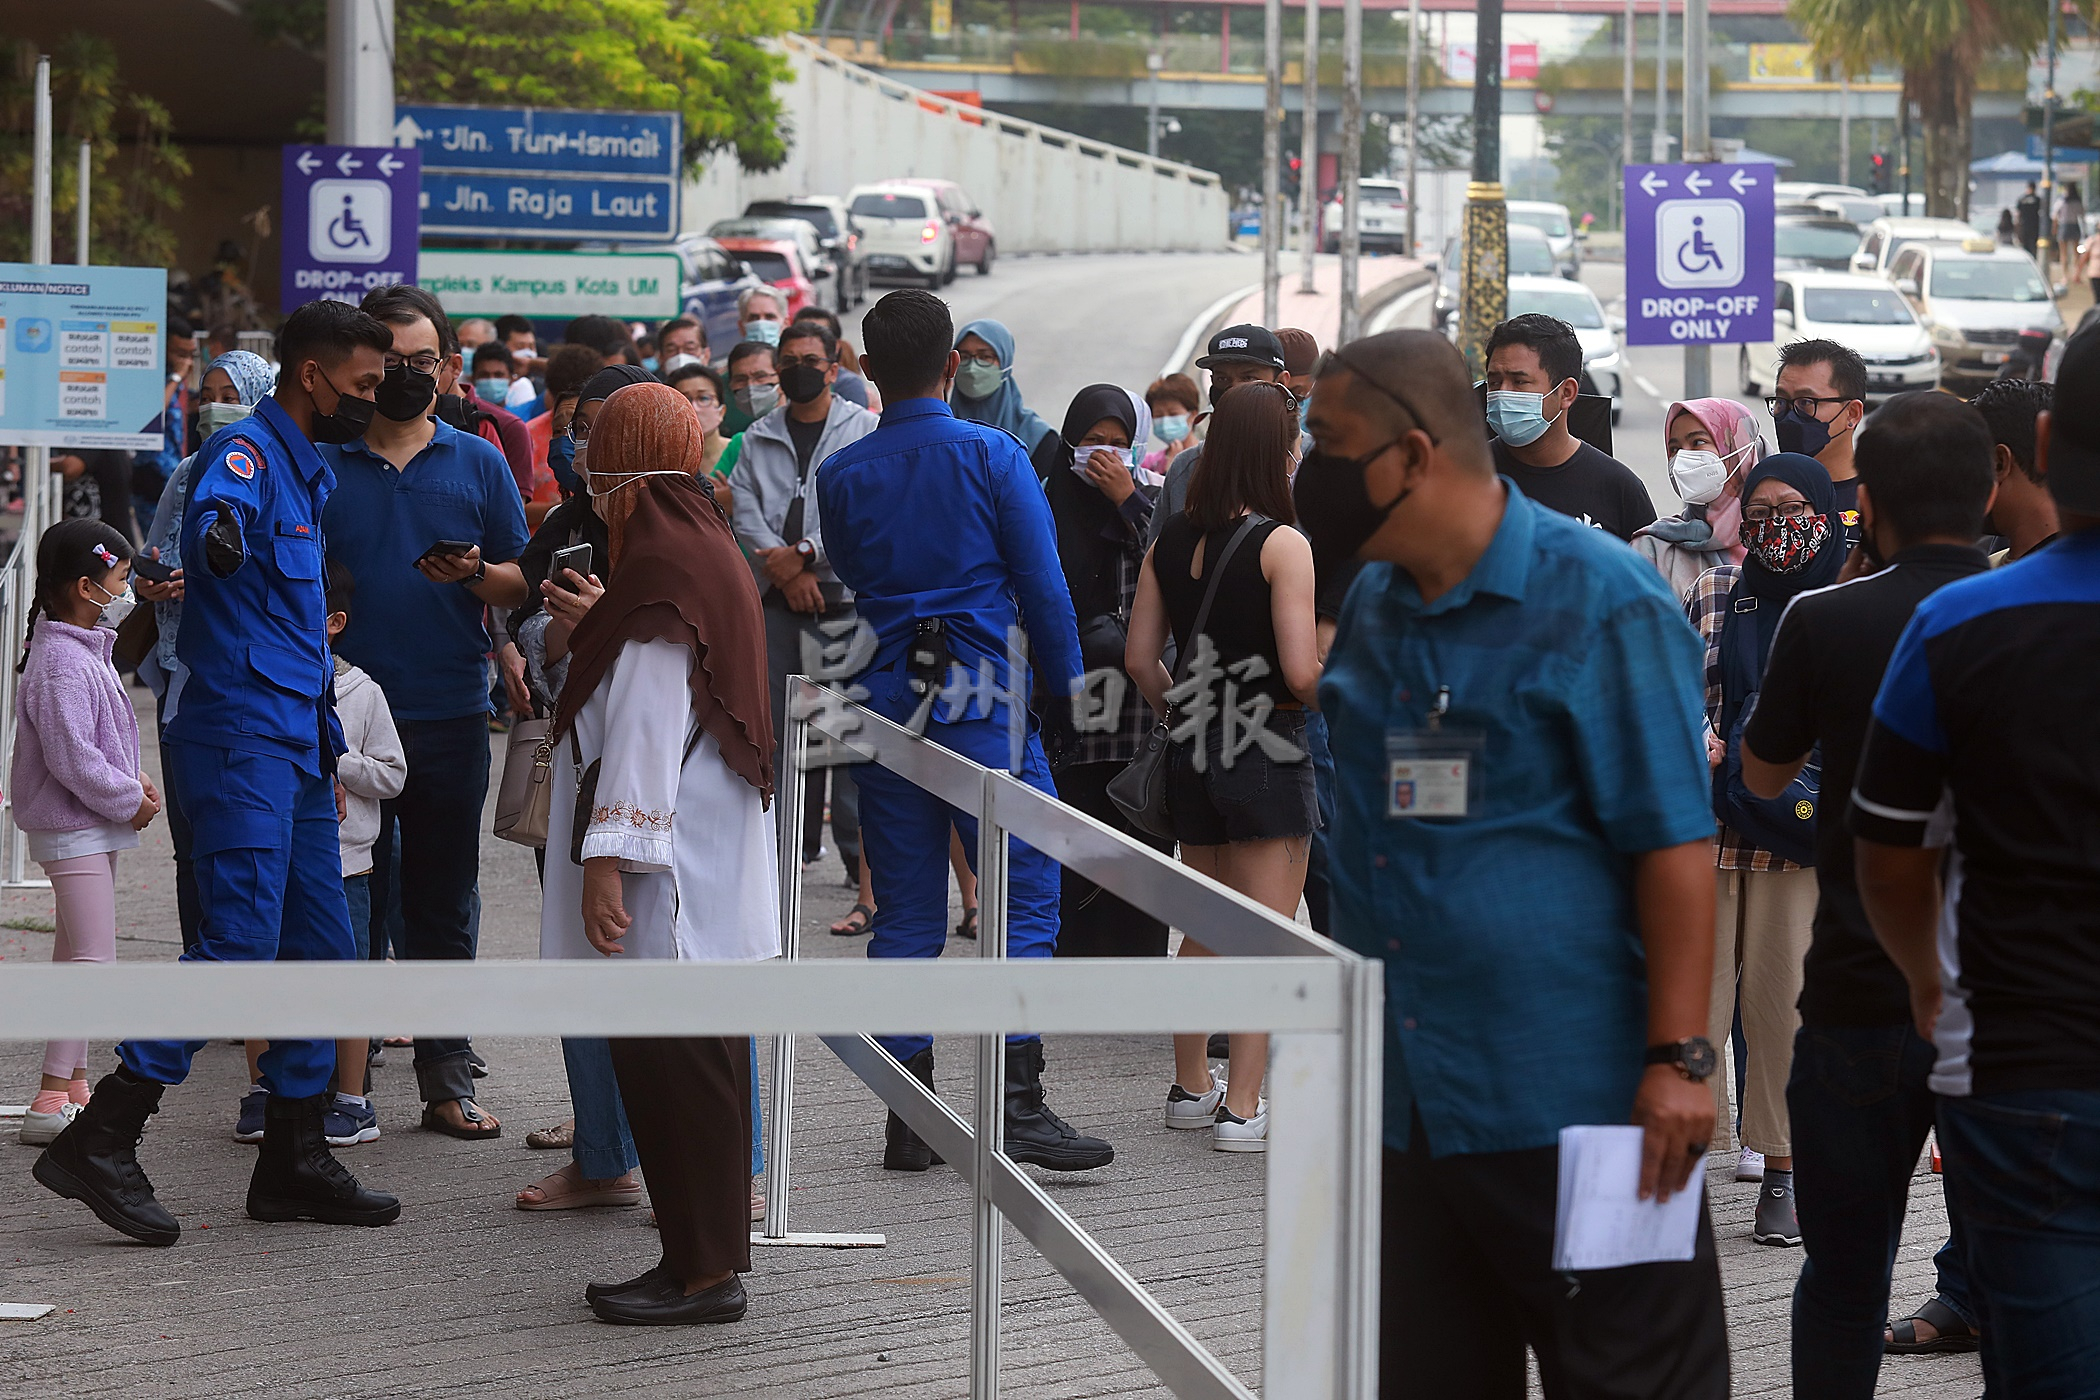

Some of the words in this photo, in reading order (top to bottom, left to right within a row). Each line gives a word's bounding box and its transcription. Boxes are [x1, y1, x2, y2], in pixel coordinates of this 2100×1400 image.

[445, 186, 495, 212] Jln.
[508, 187, 573, 219] Raja
[592, 191, 658, 217] Laut
[491, 275, 566, 296] Kampus
[576, 276, 619, 296] Kota
[628, 278, 659, 296] UM
[1641, 296, 1760, 318] DROP-OFF
[1669, 318, 1731, 340] ONLY
[64, 345, 102, 354] contoh
[114, 346, 151, 355] contoh
[64, 395, 101, 404] contoh
